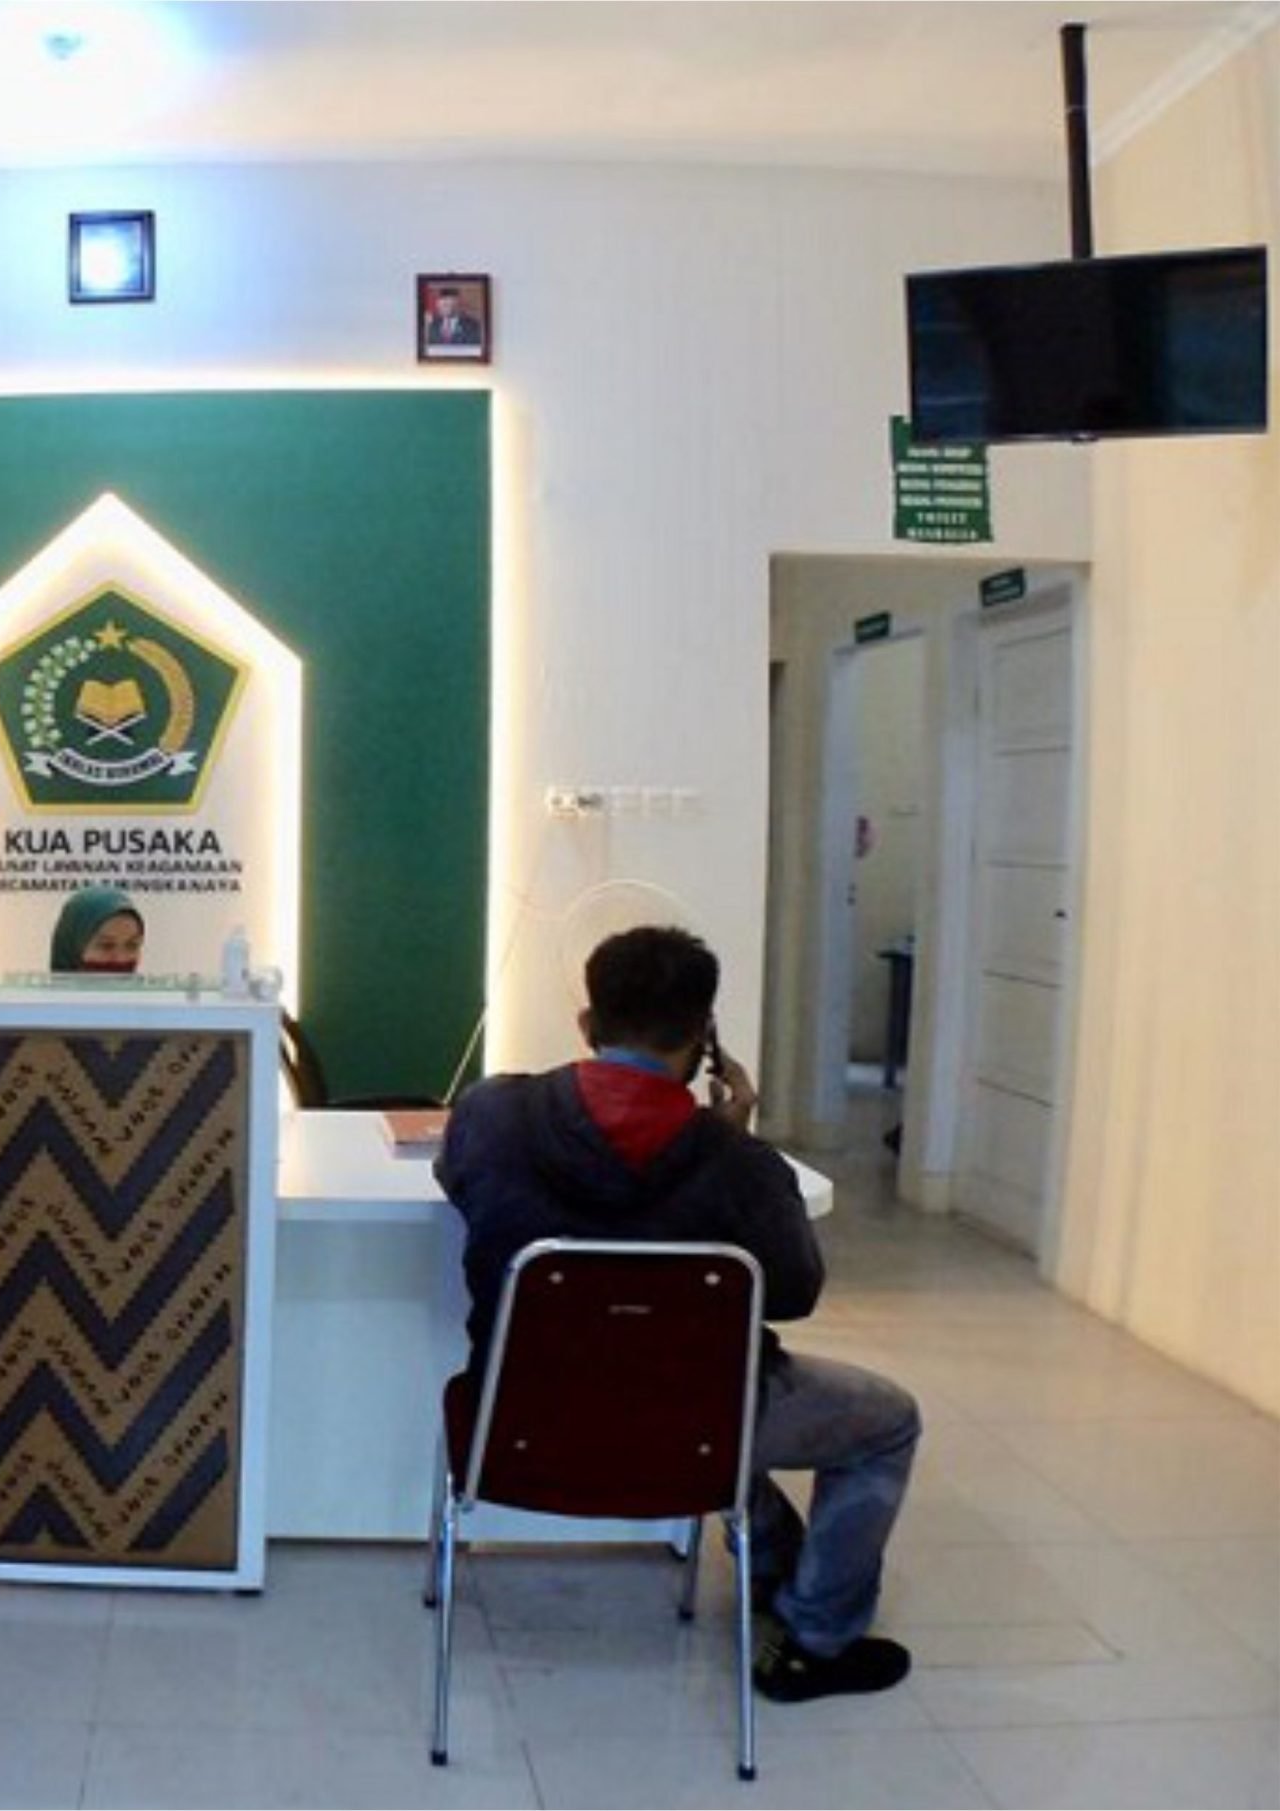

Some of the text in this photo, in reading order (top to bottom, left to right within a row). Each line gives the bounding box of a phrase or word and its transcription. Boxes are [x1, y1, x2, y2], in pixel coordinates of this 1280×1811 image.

[4, 829, 221, 854] KUA PUSAKA
[43, 860, 120, 873] LAYANAN
[125, 860, 243, 873] KEAGAMAAN
